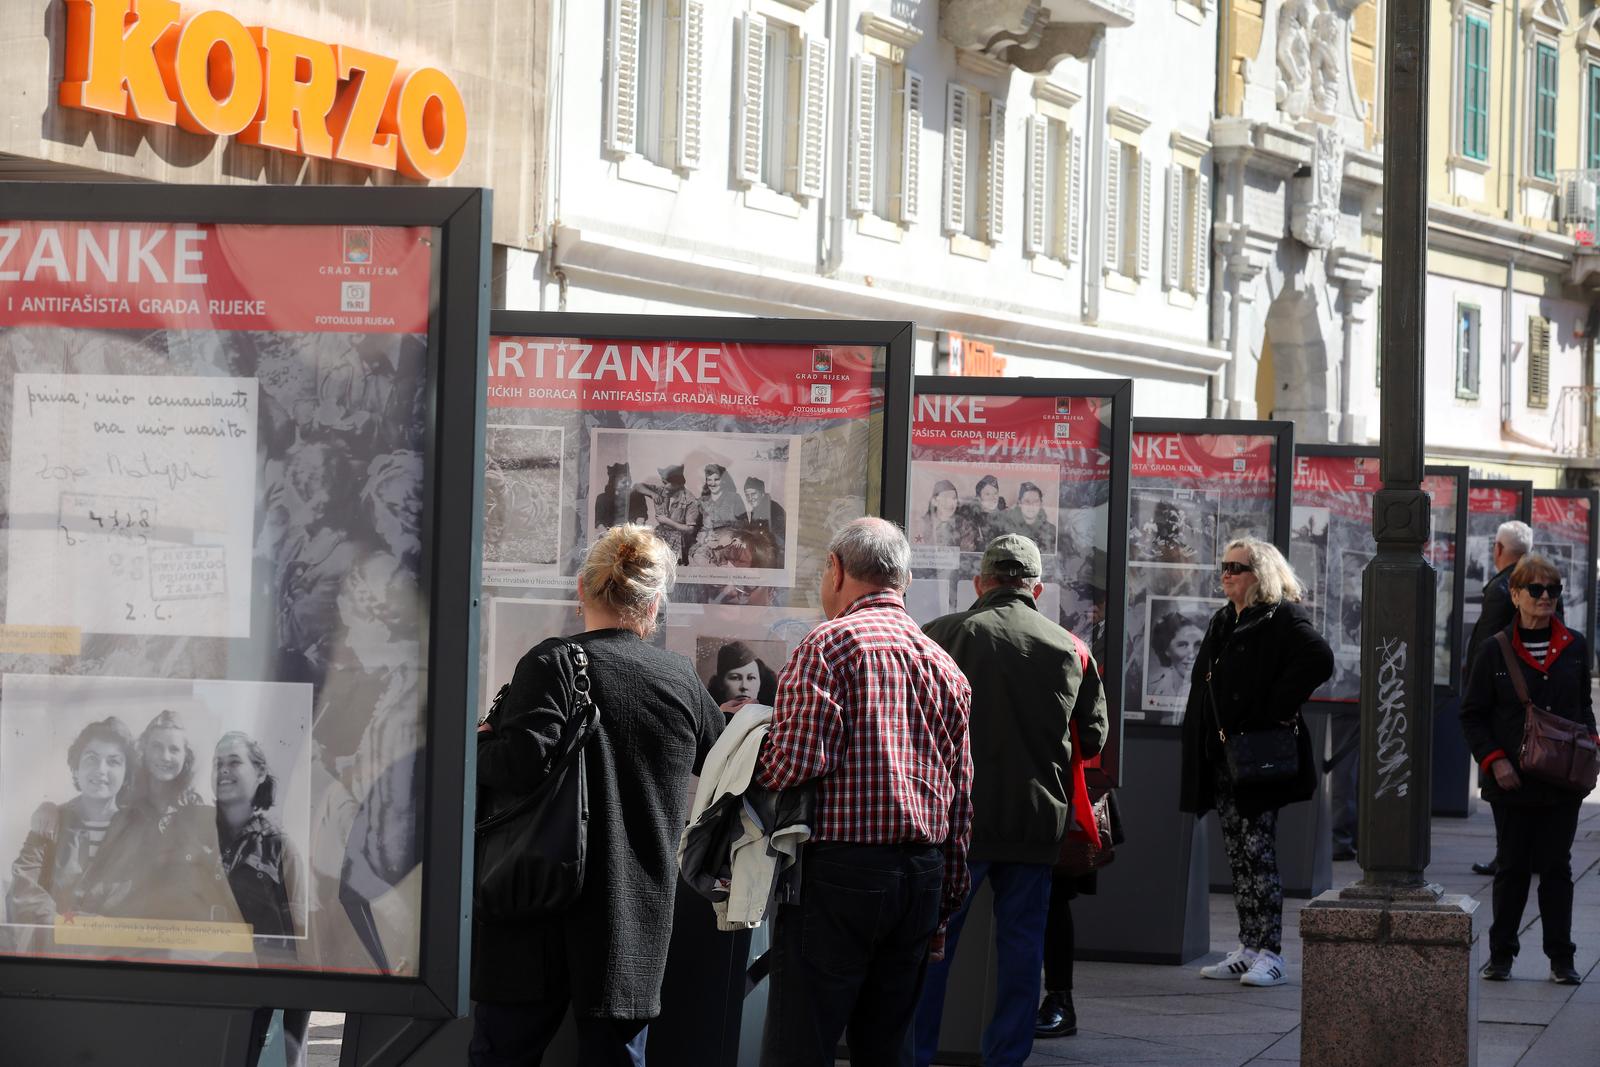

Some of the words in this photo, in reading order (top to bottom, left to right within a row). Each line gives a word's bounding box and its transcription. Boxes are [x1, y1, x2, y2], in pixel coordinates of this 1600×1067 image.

[60, 0, 468, 181] KORZO
[319, 266, 351, 275] GRAD
[359, 267, 398, 276] RIJEKA
[8, 297, 12, 312] I
[21, 295, 131, 313] ANTIFAŠISTA
[138, 298, 200, 314] GRADA
[208, 300, 266, 316] RIJEKE
[315, 316, 362, 325] FOTOKLUB
[364, 317, 395, 326] RIJEKA
[528, 387, 577, 399] BORACA
[583, 390, 586, 399] I
[592, 388, 667, 402] ANTIFAŠISTA
[673, 392, 714, 404] GRADA
[720, 394, 760, 406] RIJEKE
[912, 394, 987, 423] NKE
[950, 430, 983, 439] GRADA
[986, 431, 1016, 440] RIJEKE
[1150, 464, 1176, 472] GRADA
